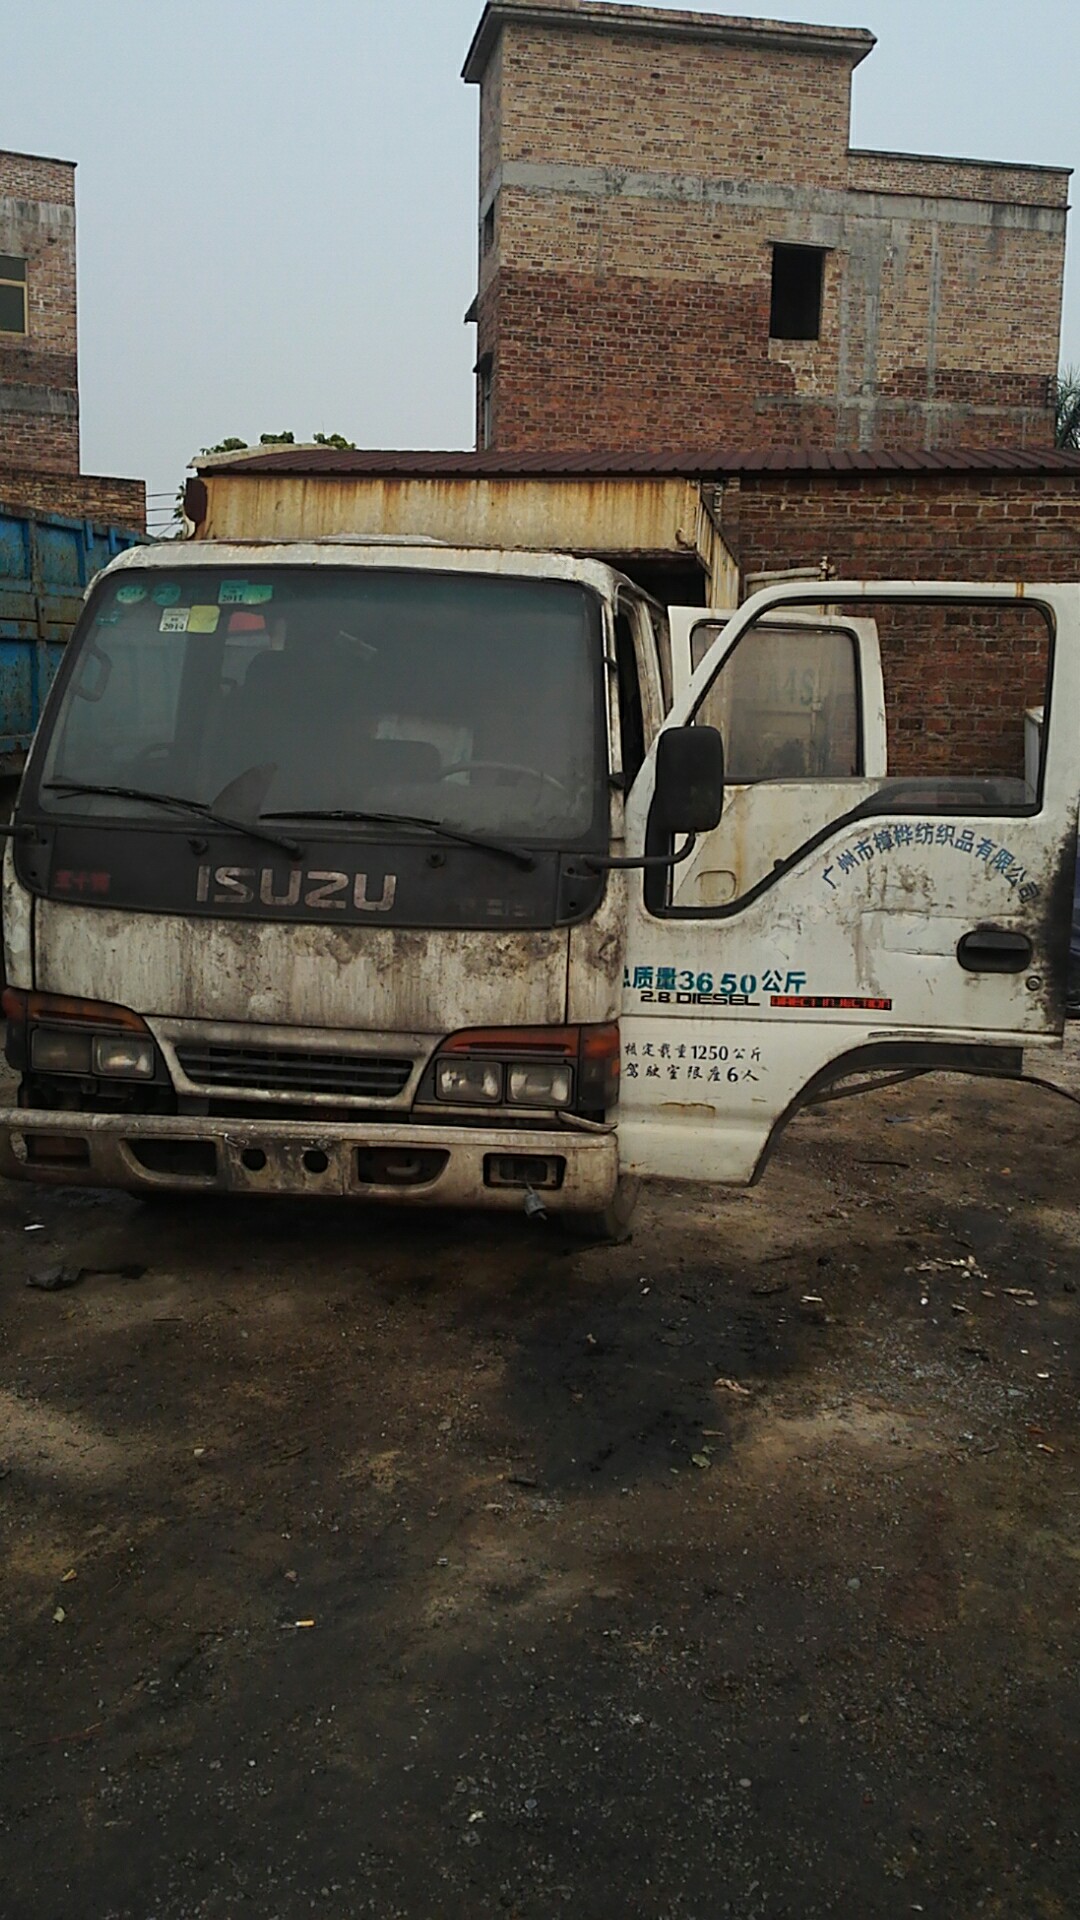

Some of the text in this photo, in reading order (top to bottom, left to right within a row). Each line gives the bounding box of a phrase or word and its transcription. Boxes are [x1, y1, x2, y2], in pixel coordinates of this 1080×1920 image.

[162, 623, 184, 632] 2014
[196, 865, 396, 911] ISUZU
[640, 990, 761, 1007] 2.8 DIESEL
